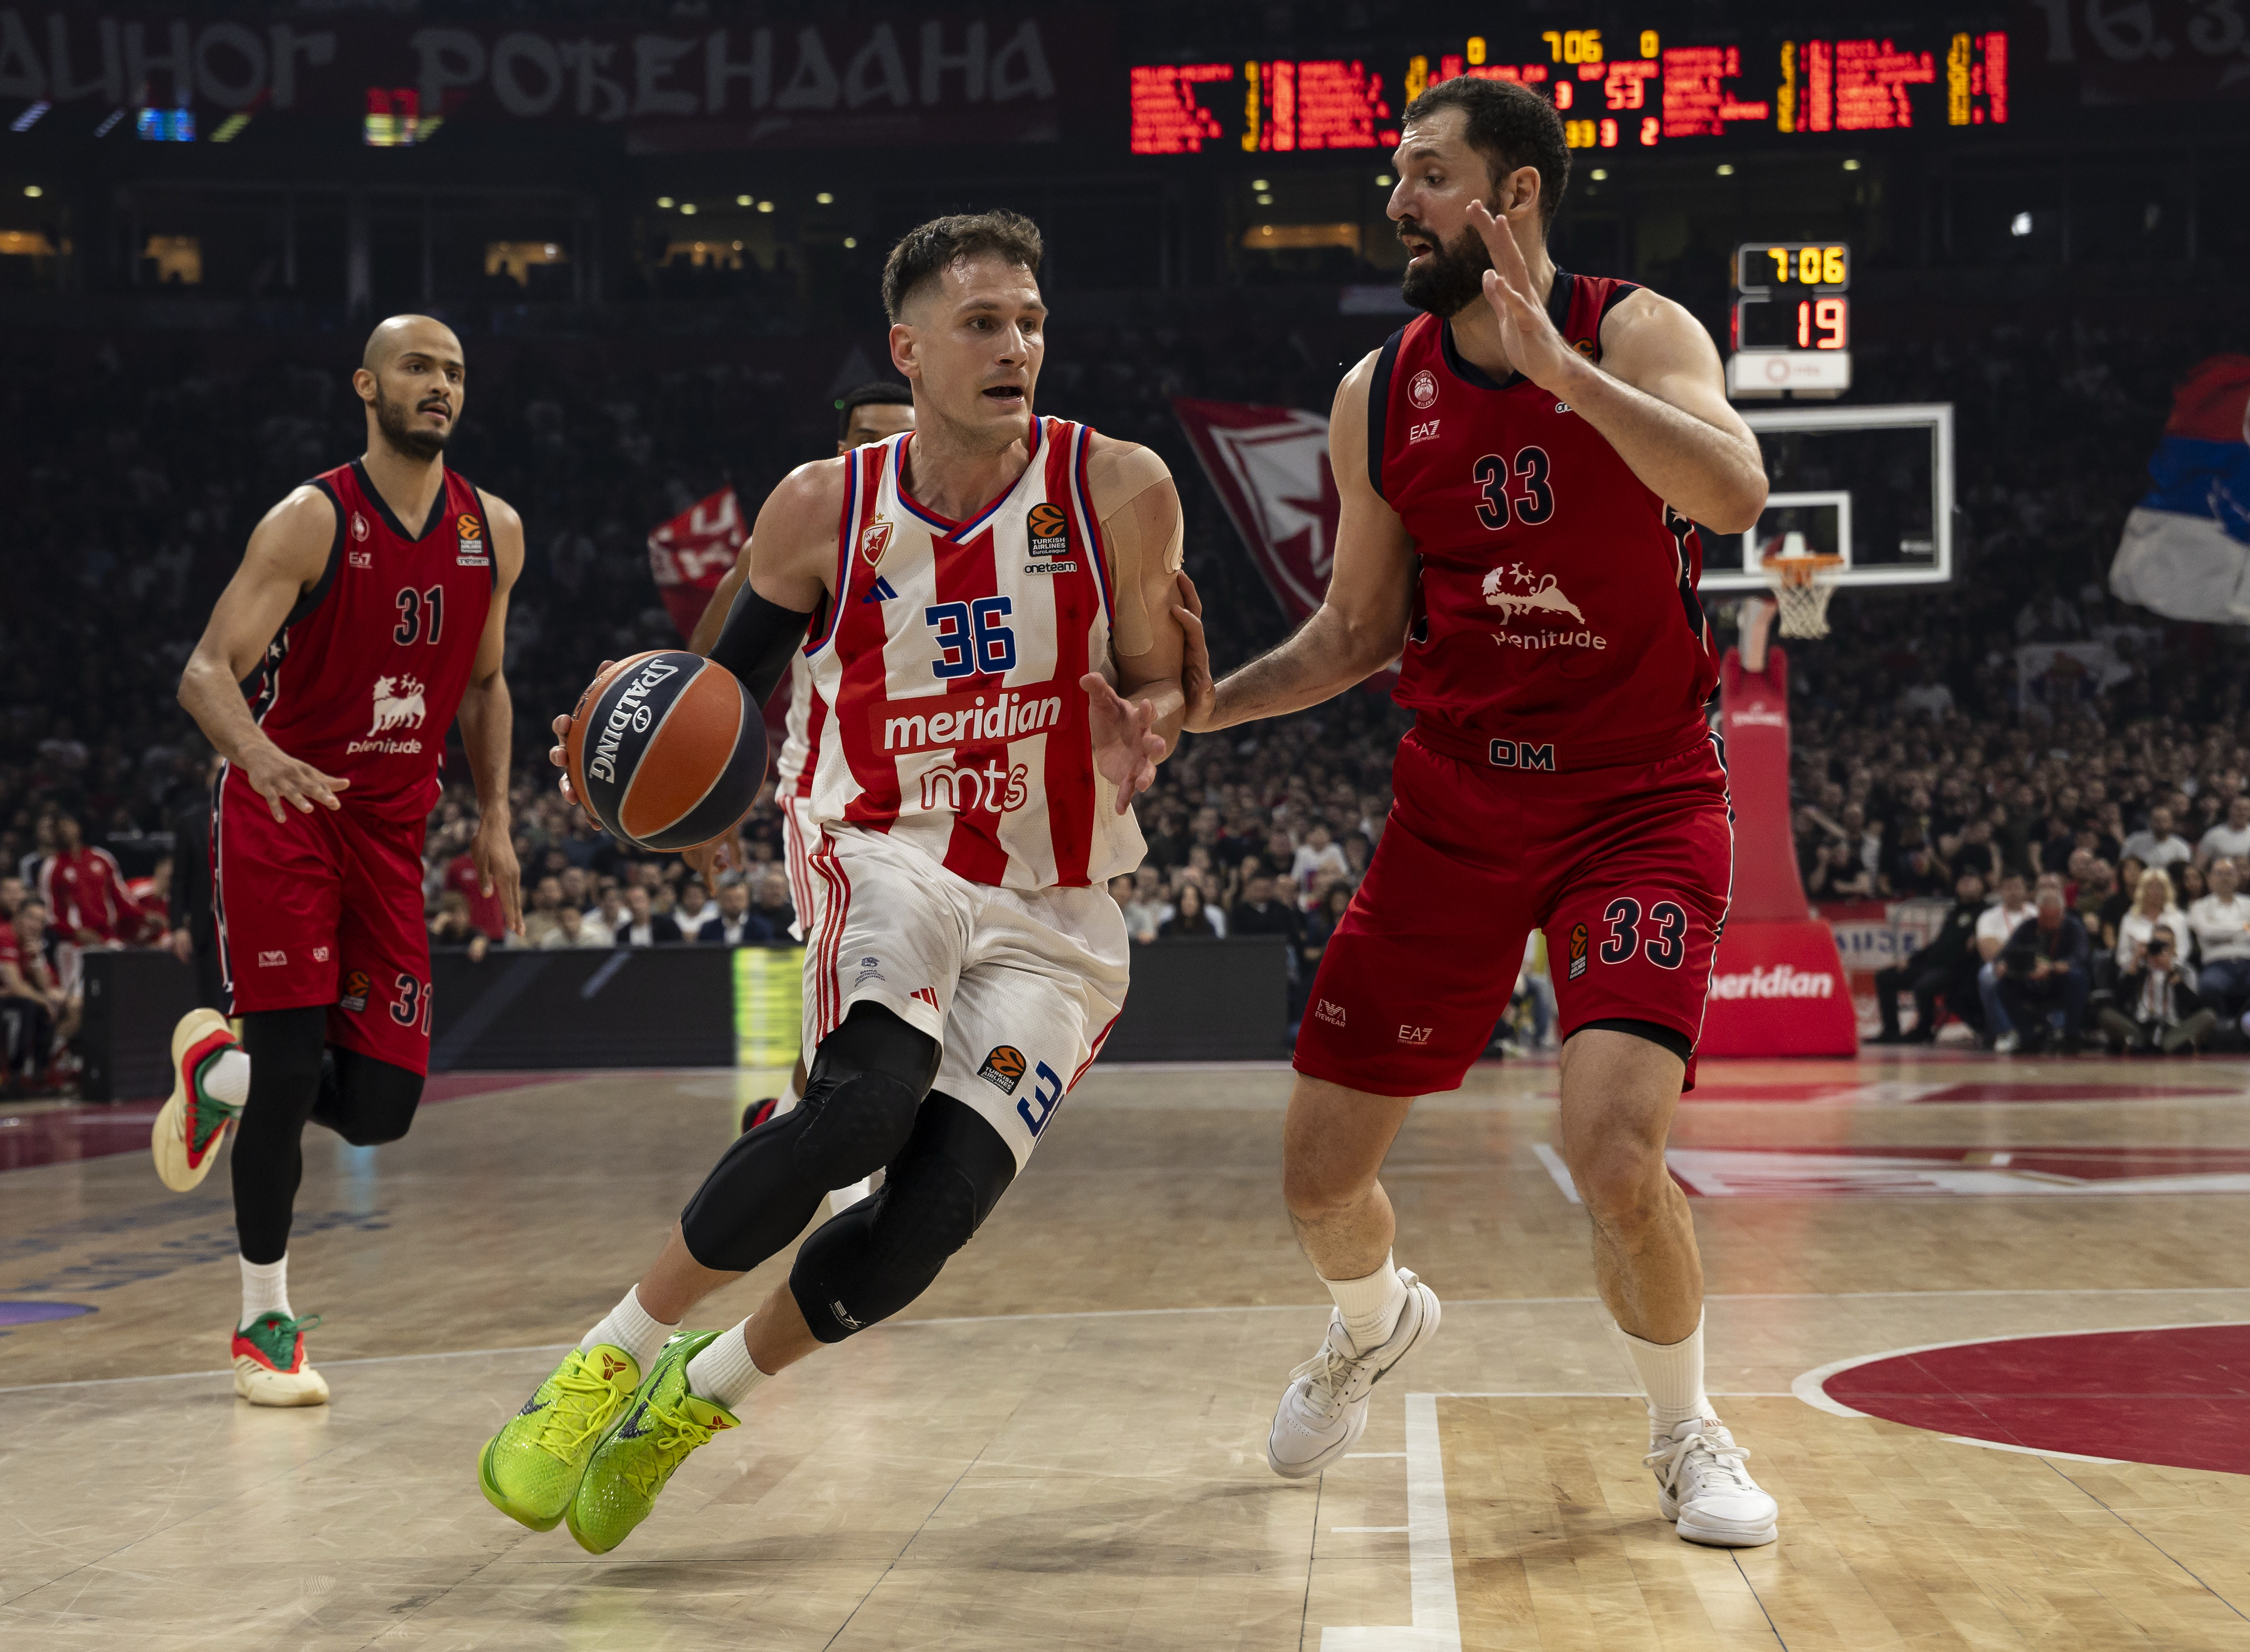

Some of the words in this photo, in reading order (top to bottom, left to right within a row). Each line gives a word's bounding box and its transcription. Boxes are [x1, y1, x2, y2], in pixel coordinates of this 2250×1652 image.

[1640, 117, 1660, 146] 2
[1768, 247, 1846, 284] 7:06
[1798, 298, 1846, 349] 19
[1410, 419, 1440, 441] EA7
[1473, 445, 1555, 530] 33
[1024, 562, 1076, 573] oneteam
[393, 584, 444, 645] 31
[924, 595, 1017, 679] 36
[589, 659, 679, 784] SPALDING
[883, 693, 1062, 750] meridian
[1489, 738, 1556, 771] OM
[920, 759, 1029, 813] mts
[1600, 897, 1687, 970] 33
[390, 973, 432, 1037] 31
[1315, 1011, 1346, 1028] EYEWEAR
[1398, 1024, 1433, 1041] EA7
[981, 1071, 1012, 1090] AIRLINES
[986, 1066, 1015, 1086] TURKISH
[1015, 1060, 1065, 1149] 3
